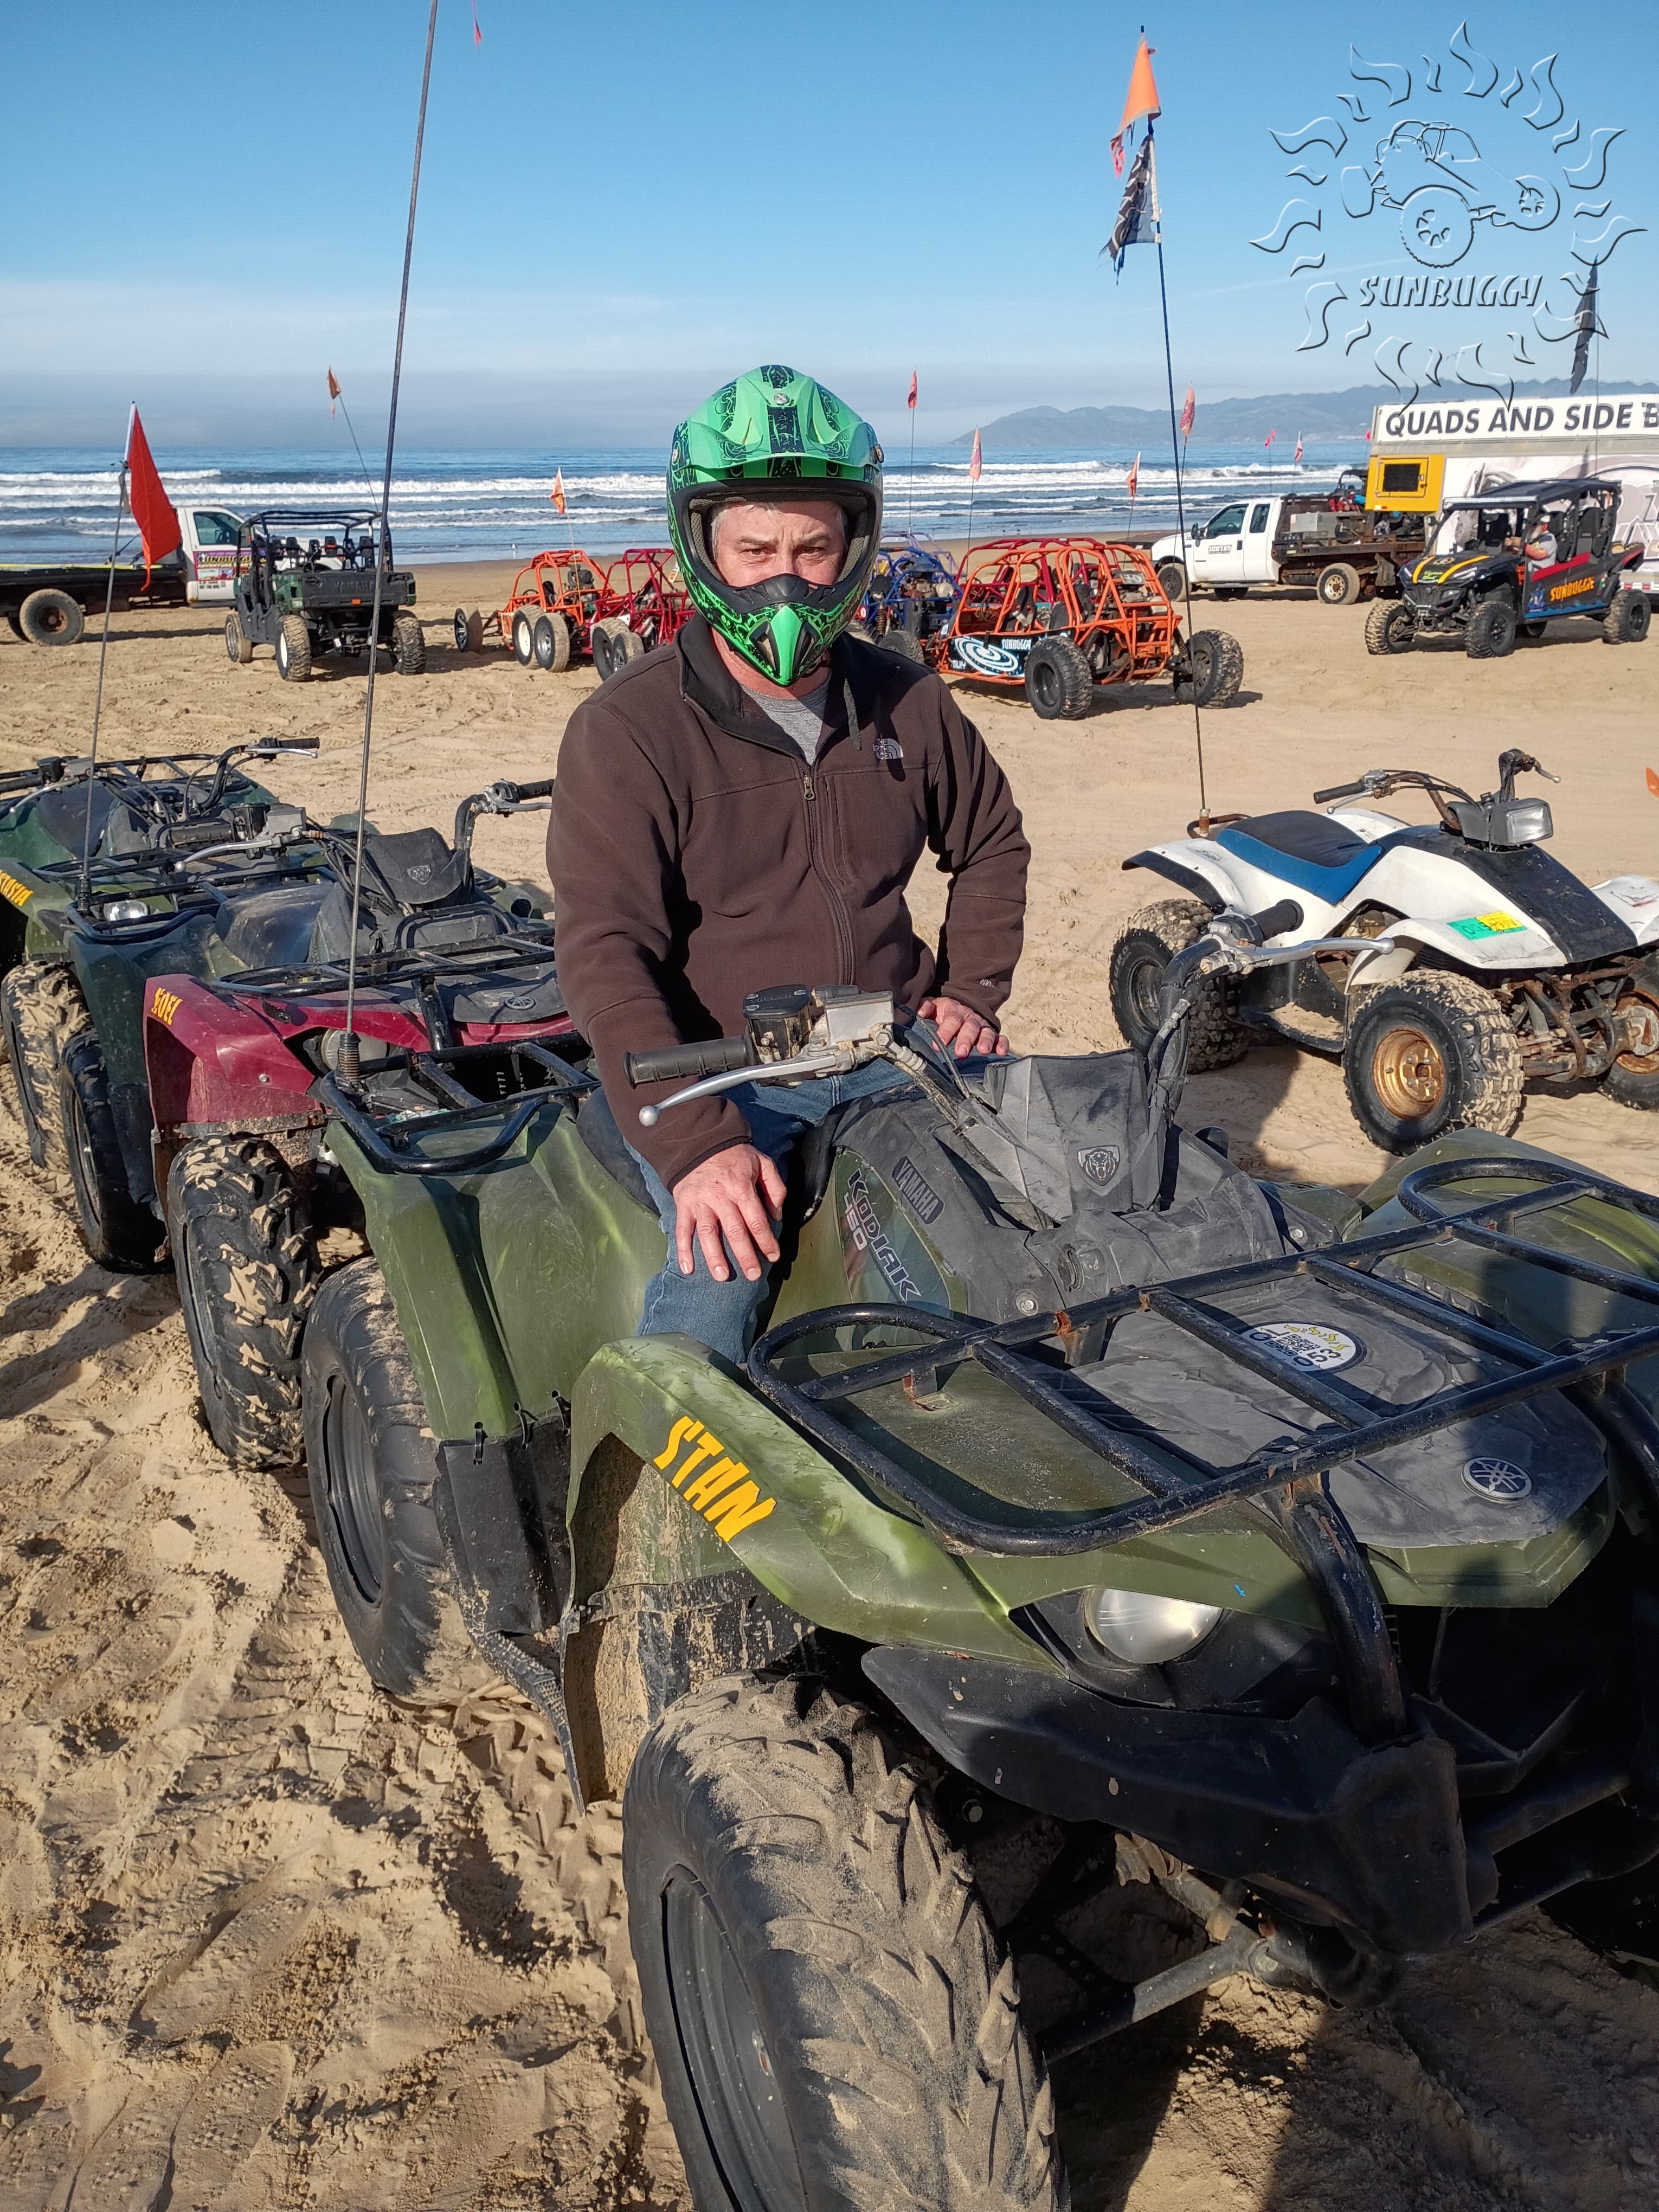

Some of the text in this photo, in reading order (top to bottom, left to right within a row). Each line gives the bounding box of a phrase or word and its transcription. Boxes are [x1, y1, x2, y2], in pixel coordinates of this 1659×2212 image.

[1386, 408, 1480, 438] QUADS
[1488, 405, 1555, 433] AND
[1564, 402, 1634, 431] SIDE
[896, 1159, 939, 1220] YAMAHA
[844, 1192, 867, 1251] 450
[847, 1168, 922, 1304] KODIAK
[653, 1416, 777, 1543] STAN
